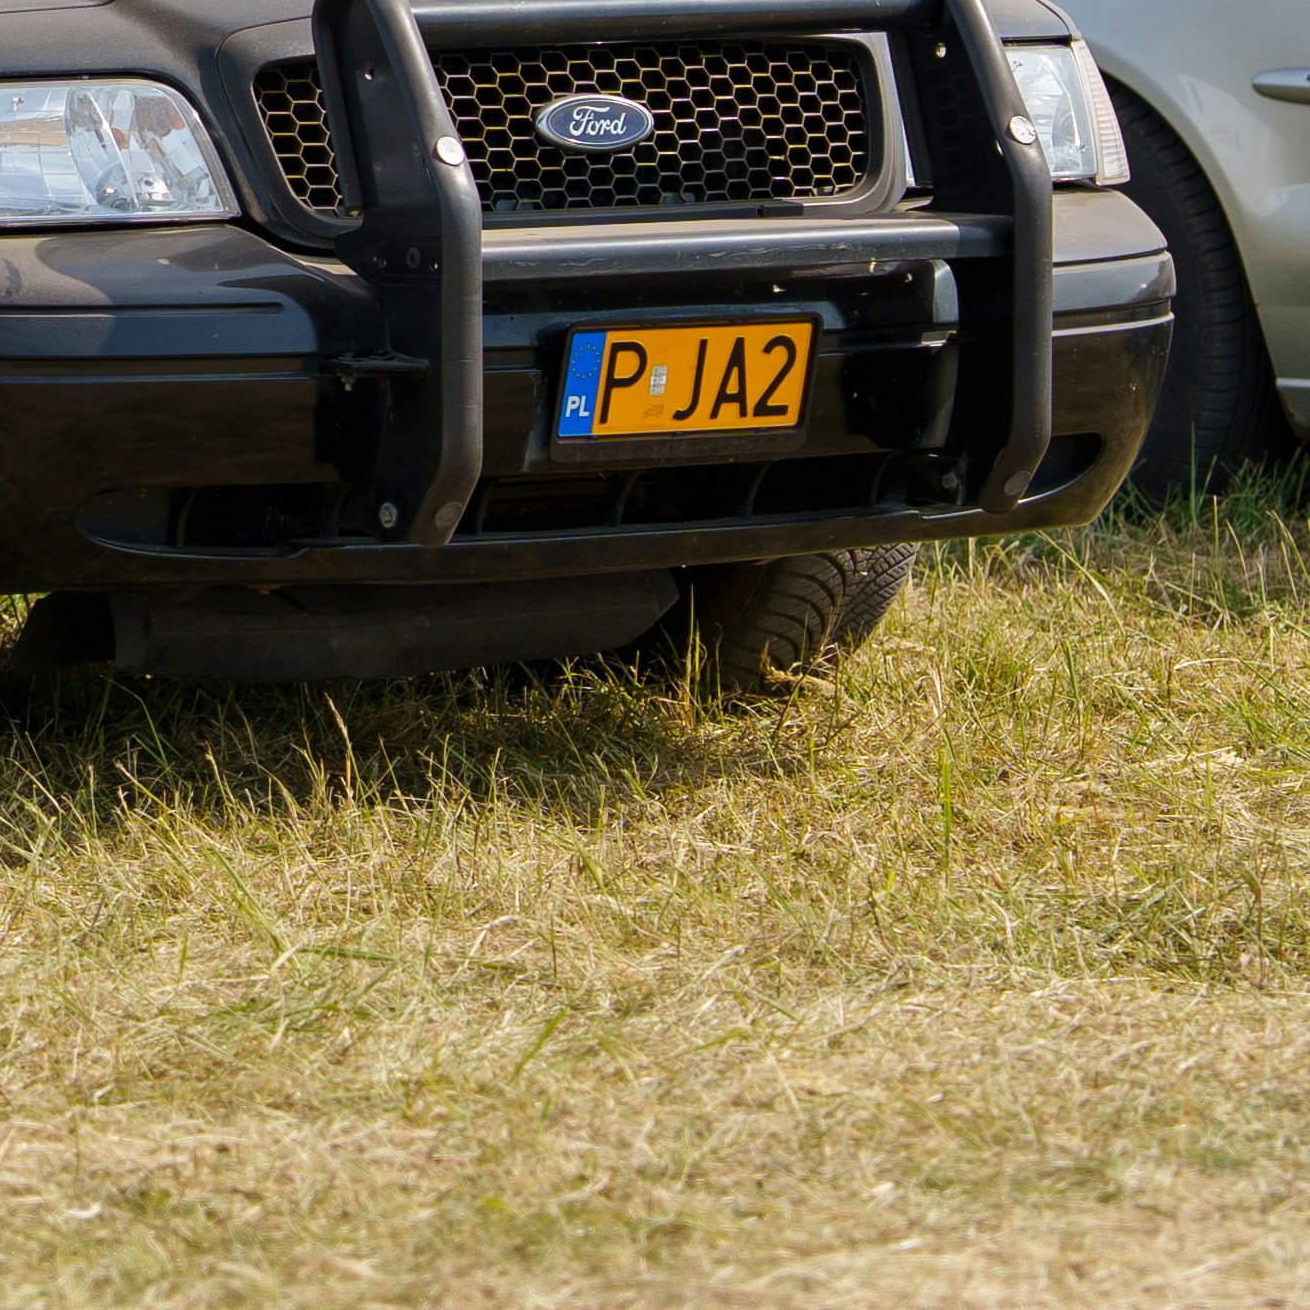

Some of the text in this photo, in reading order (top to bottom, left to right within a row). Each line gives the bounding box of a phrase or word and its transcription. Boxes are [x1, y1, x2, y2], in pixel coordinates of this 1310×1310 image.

[569, 105, 628, 137] Ford
[599, 334, 798, 425] P JA2
[565, 395, 590, 418] PL
